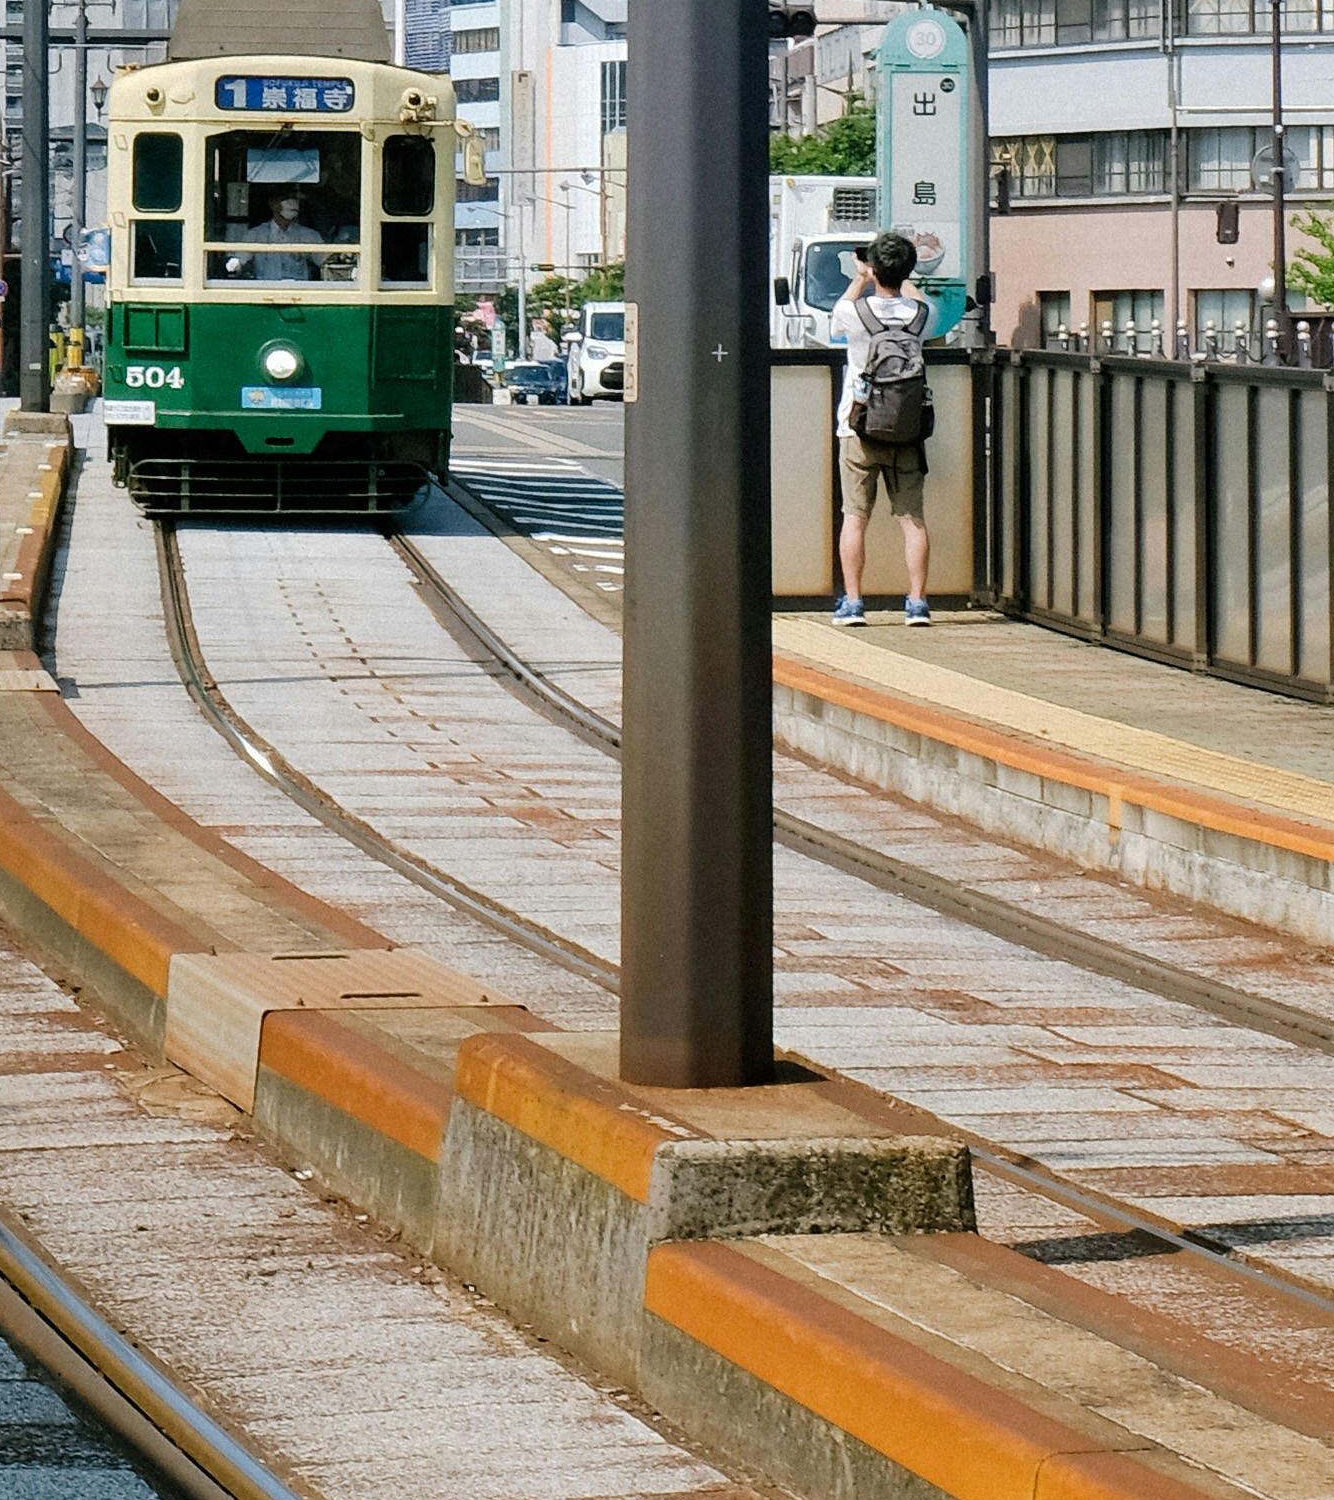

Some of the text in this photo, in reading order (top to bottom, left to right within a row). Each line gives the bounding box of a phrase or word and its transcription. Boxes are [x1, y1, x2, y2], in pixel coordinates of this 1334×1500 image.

[916, 31, 936, 46] 30
[225, 80, 348, 110] 1 崇福寺
[912, 91, 937, 206] 出島
[126, 366, 185, 389] 504
